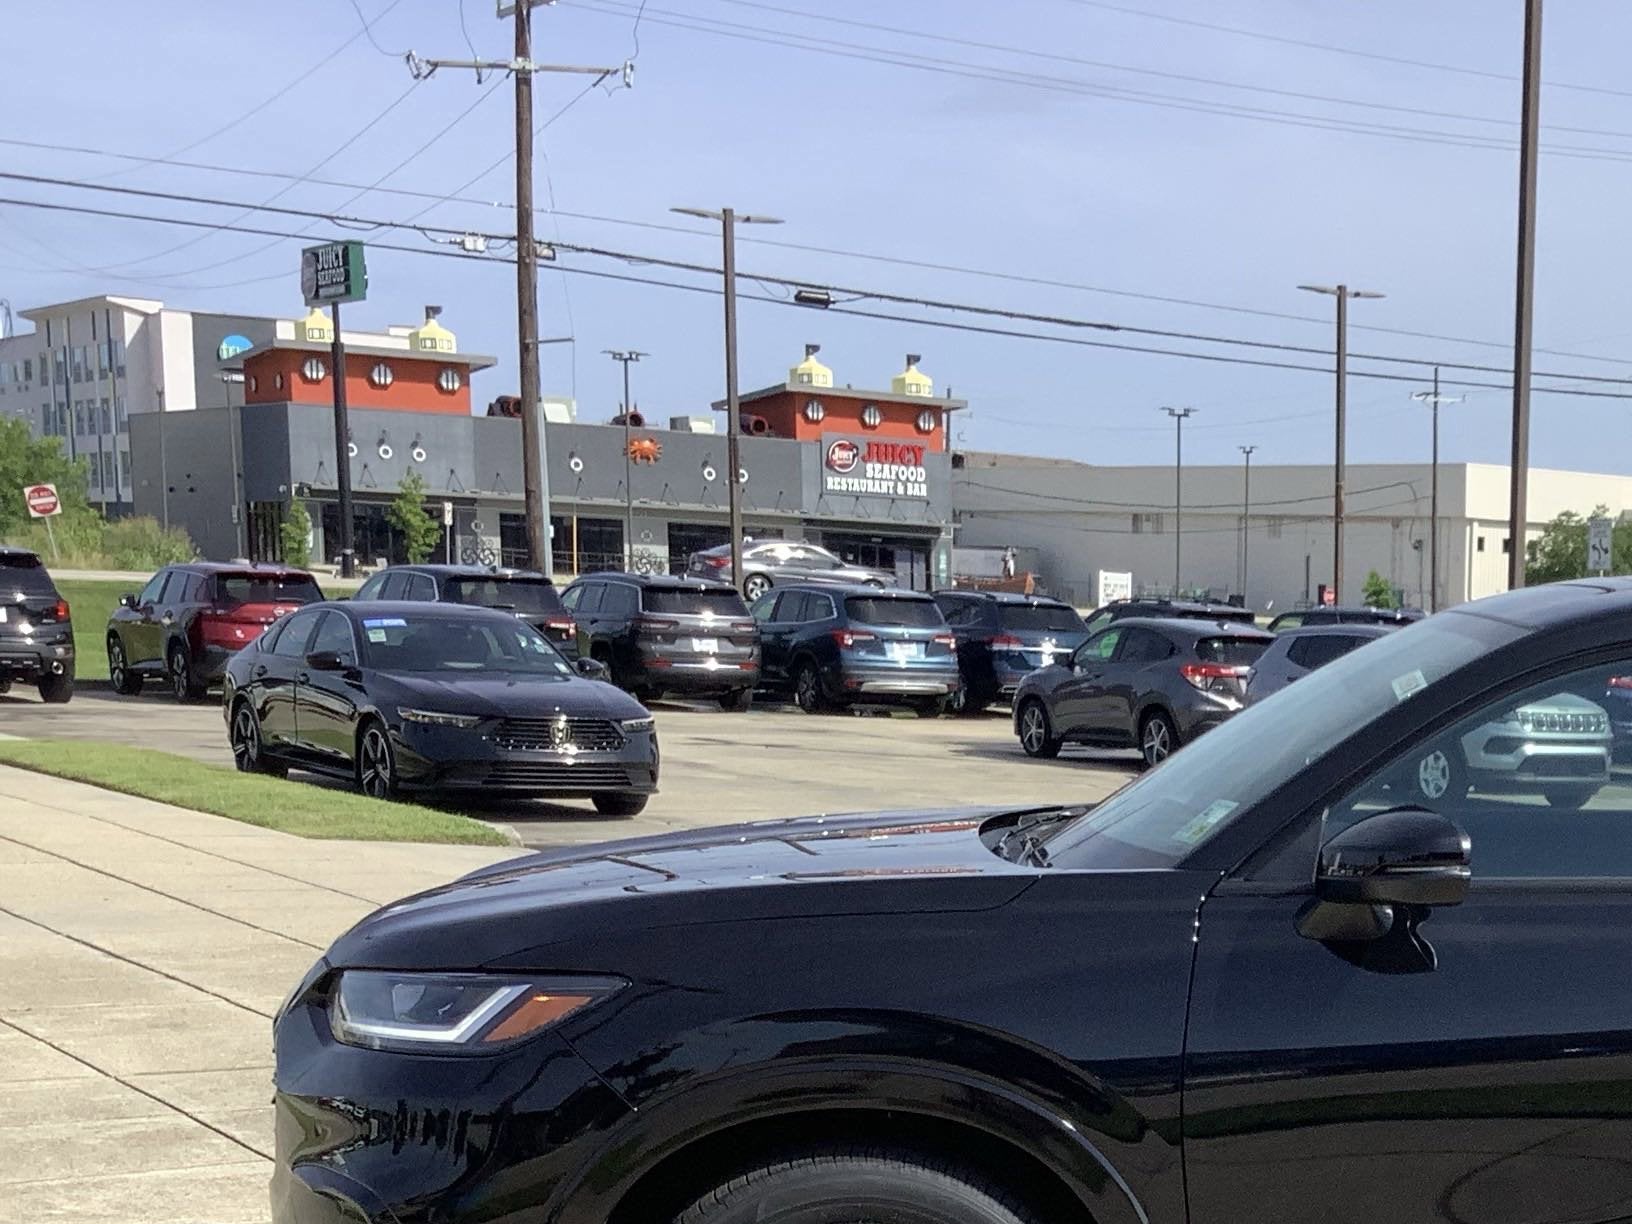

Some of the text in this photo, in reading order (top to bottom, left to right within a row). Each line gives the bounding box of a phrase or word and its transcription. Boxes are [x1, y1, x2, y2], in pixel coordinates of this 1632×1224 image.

[317, 245, 345, 271] JUICY
[861, 441, 925, 466] JUICY
[865, 463, 926, 482] SEAFOOD
[826, 476, 928, 497] RESTAURANT & BAR
